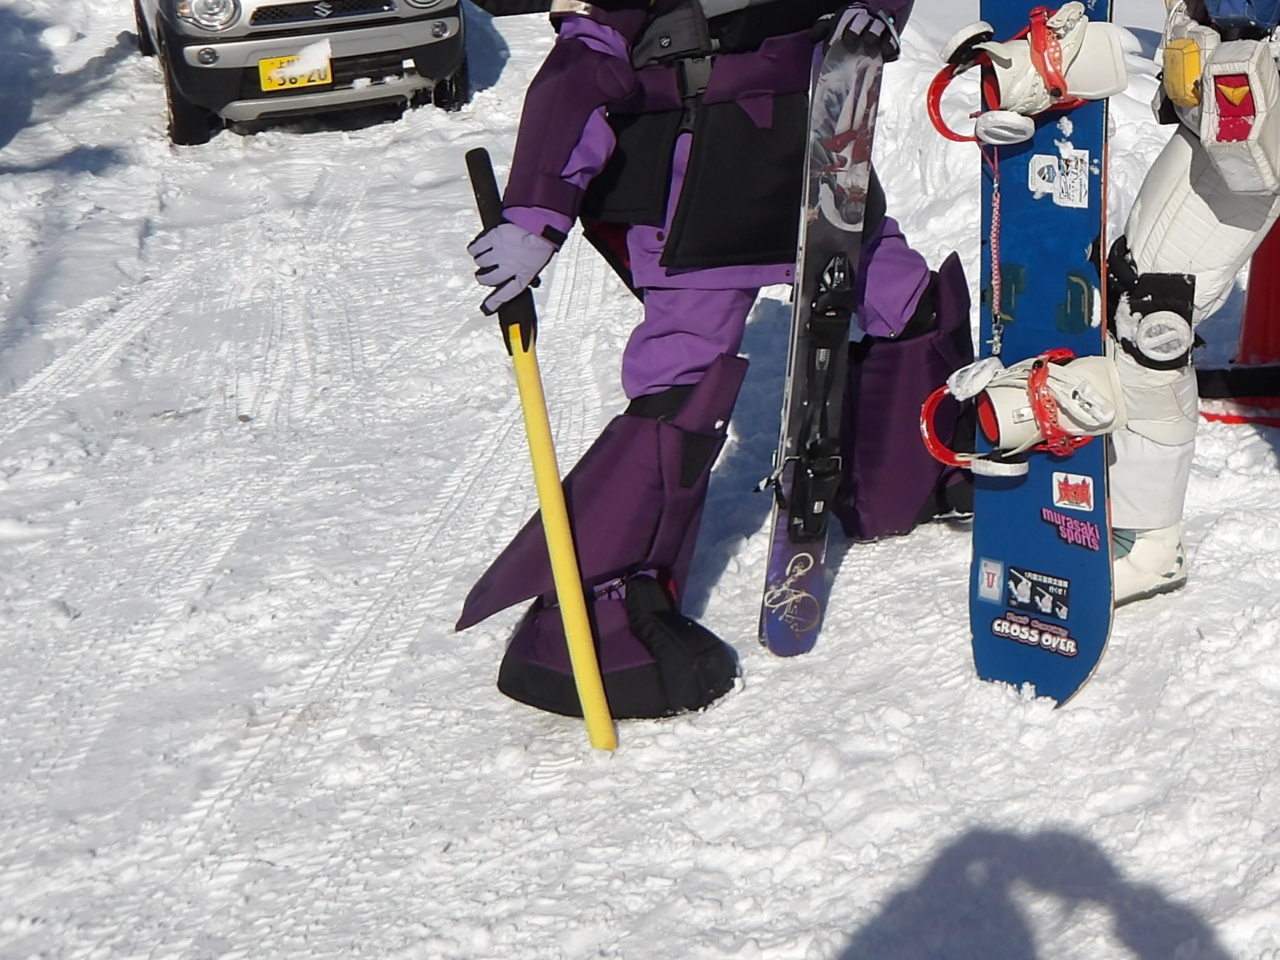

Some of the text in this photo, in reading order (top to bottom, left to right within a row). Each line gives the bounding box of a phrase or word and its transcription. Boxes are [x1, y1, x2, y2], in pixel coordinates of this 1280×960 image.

[1042, 507, 1100, 540] murasaki
[1060, 525, 1099, 551] sports
[993, 619, 1040, 642] CROSS
[1041, 632, 1077, 653] OVER
